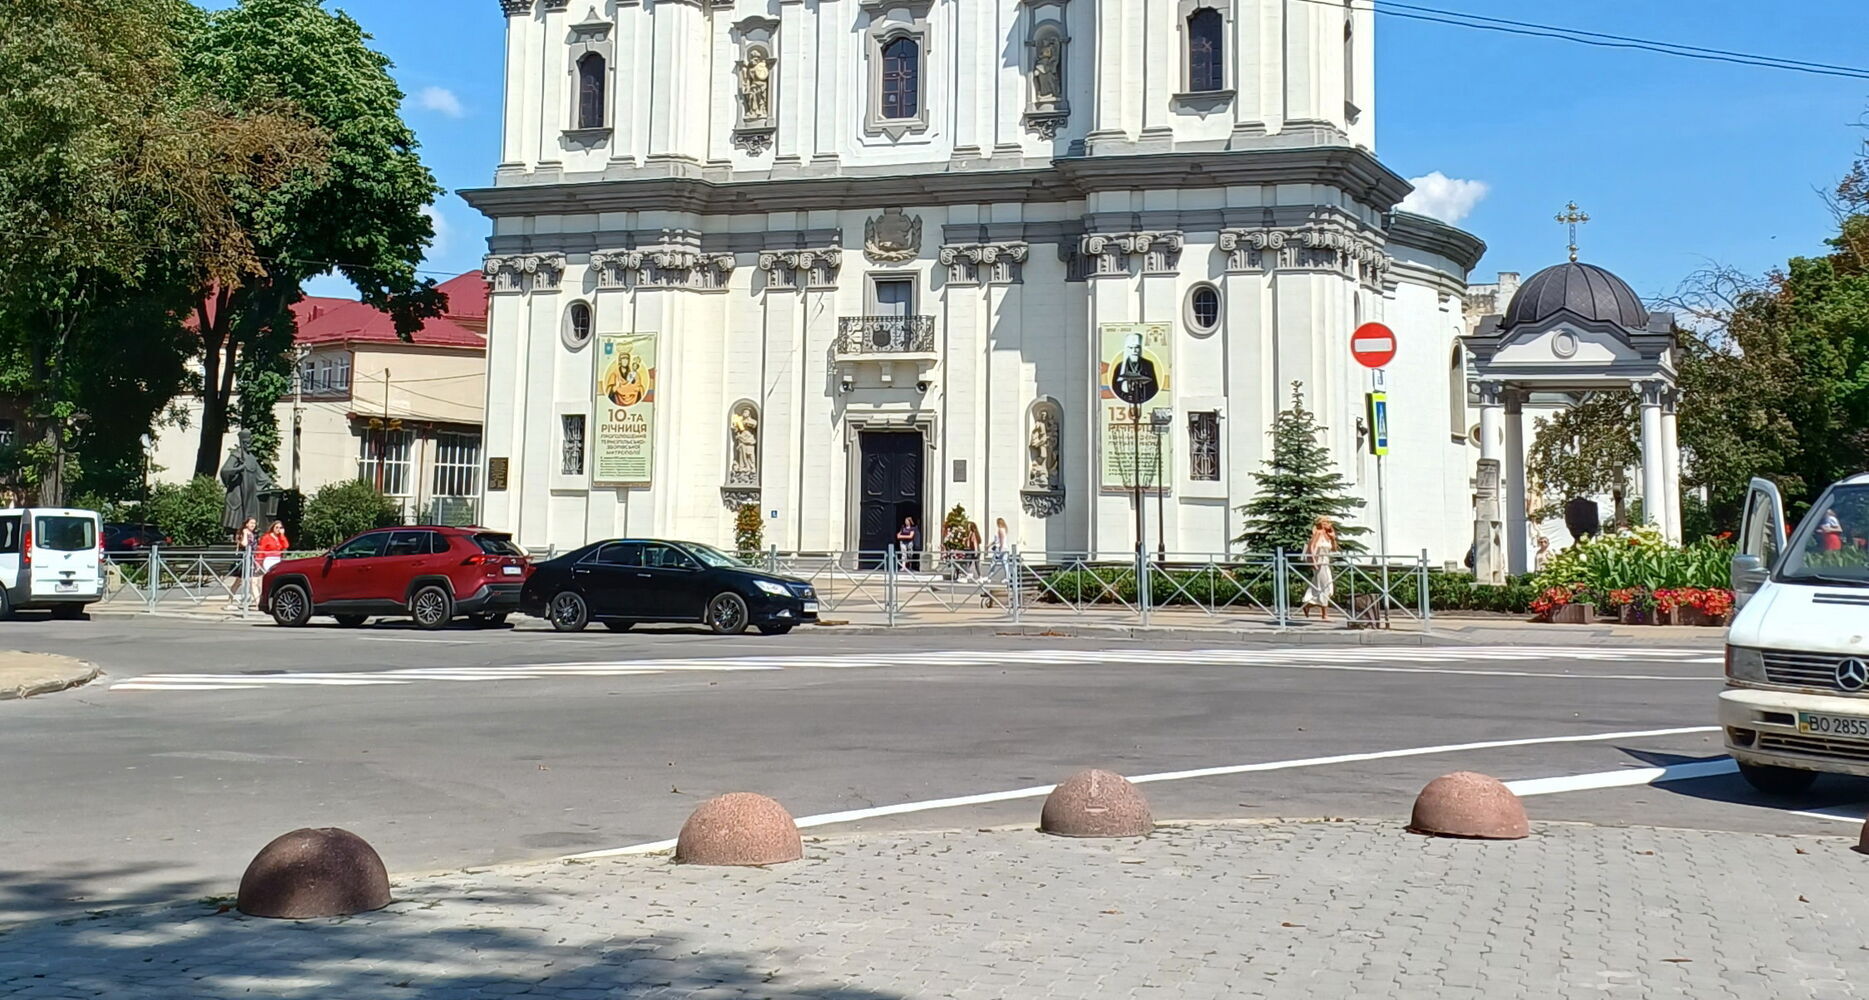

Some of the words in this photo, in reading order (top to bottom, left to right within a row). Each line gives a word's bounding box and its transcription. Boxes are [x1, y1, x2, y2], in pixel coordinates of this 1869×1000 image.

[608, 408, 644, 422] 10-ТА
[601, 424, 647, 433] РІЧНИЦЯ
[1809, 715, 1830, 732] BO
[1833, 718, 1868, 735] 2855
